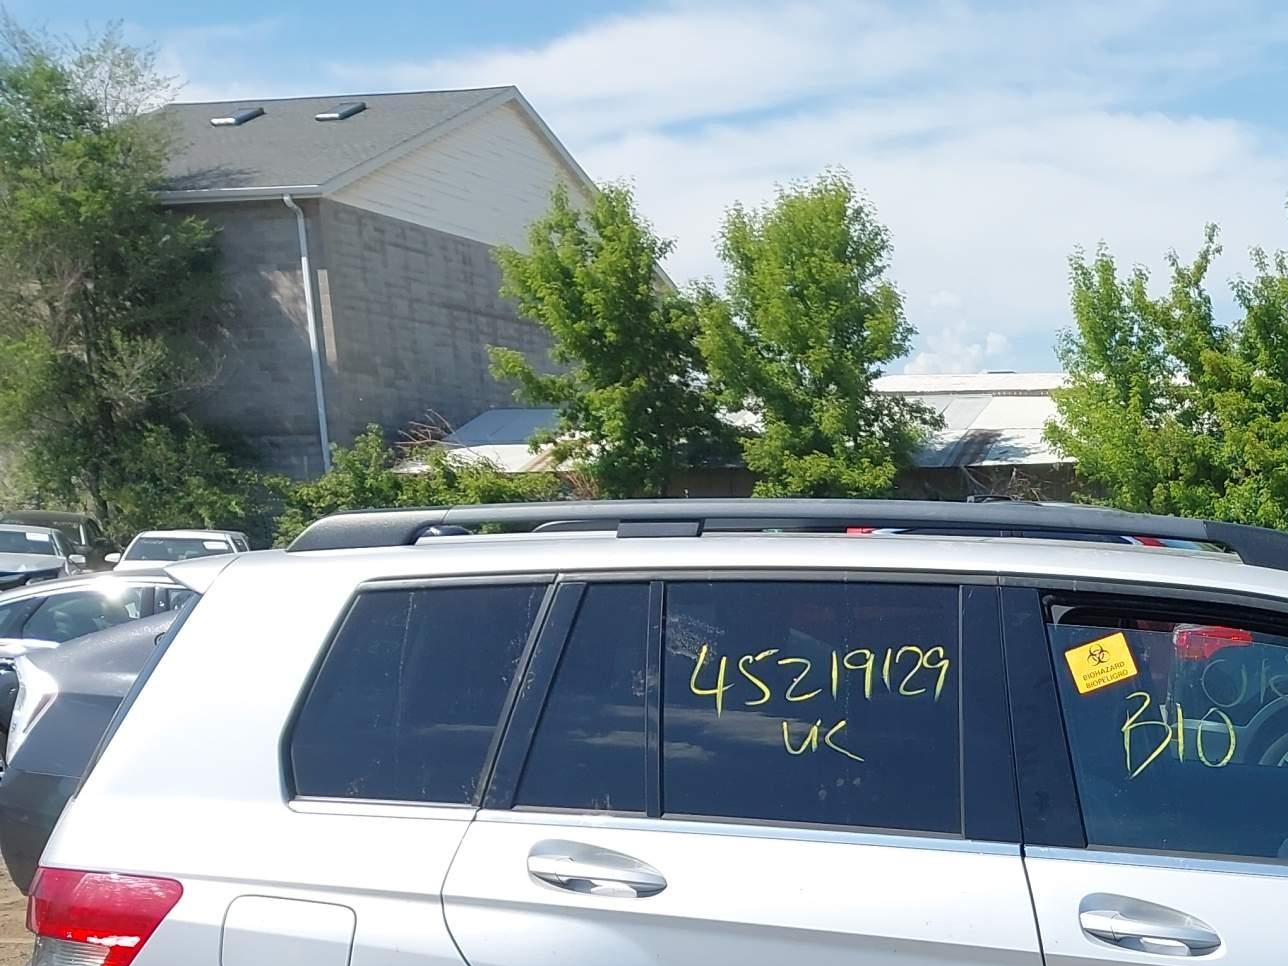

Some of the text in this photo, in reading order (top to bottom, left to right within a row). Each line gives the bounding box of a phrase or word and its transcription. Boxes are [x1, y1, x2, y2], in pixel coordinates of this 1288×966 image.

[688, 644, 950, 718] 45219129
[1083, 662, 1125, 680] BIOHAZARD
[1085, 670, 1128, 688] BIOPELIGRO
[1121, 691, 1237, 780] BIO
